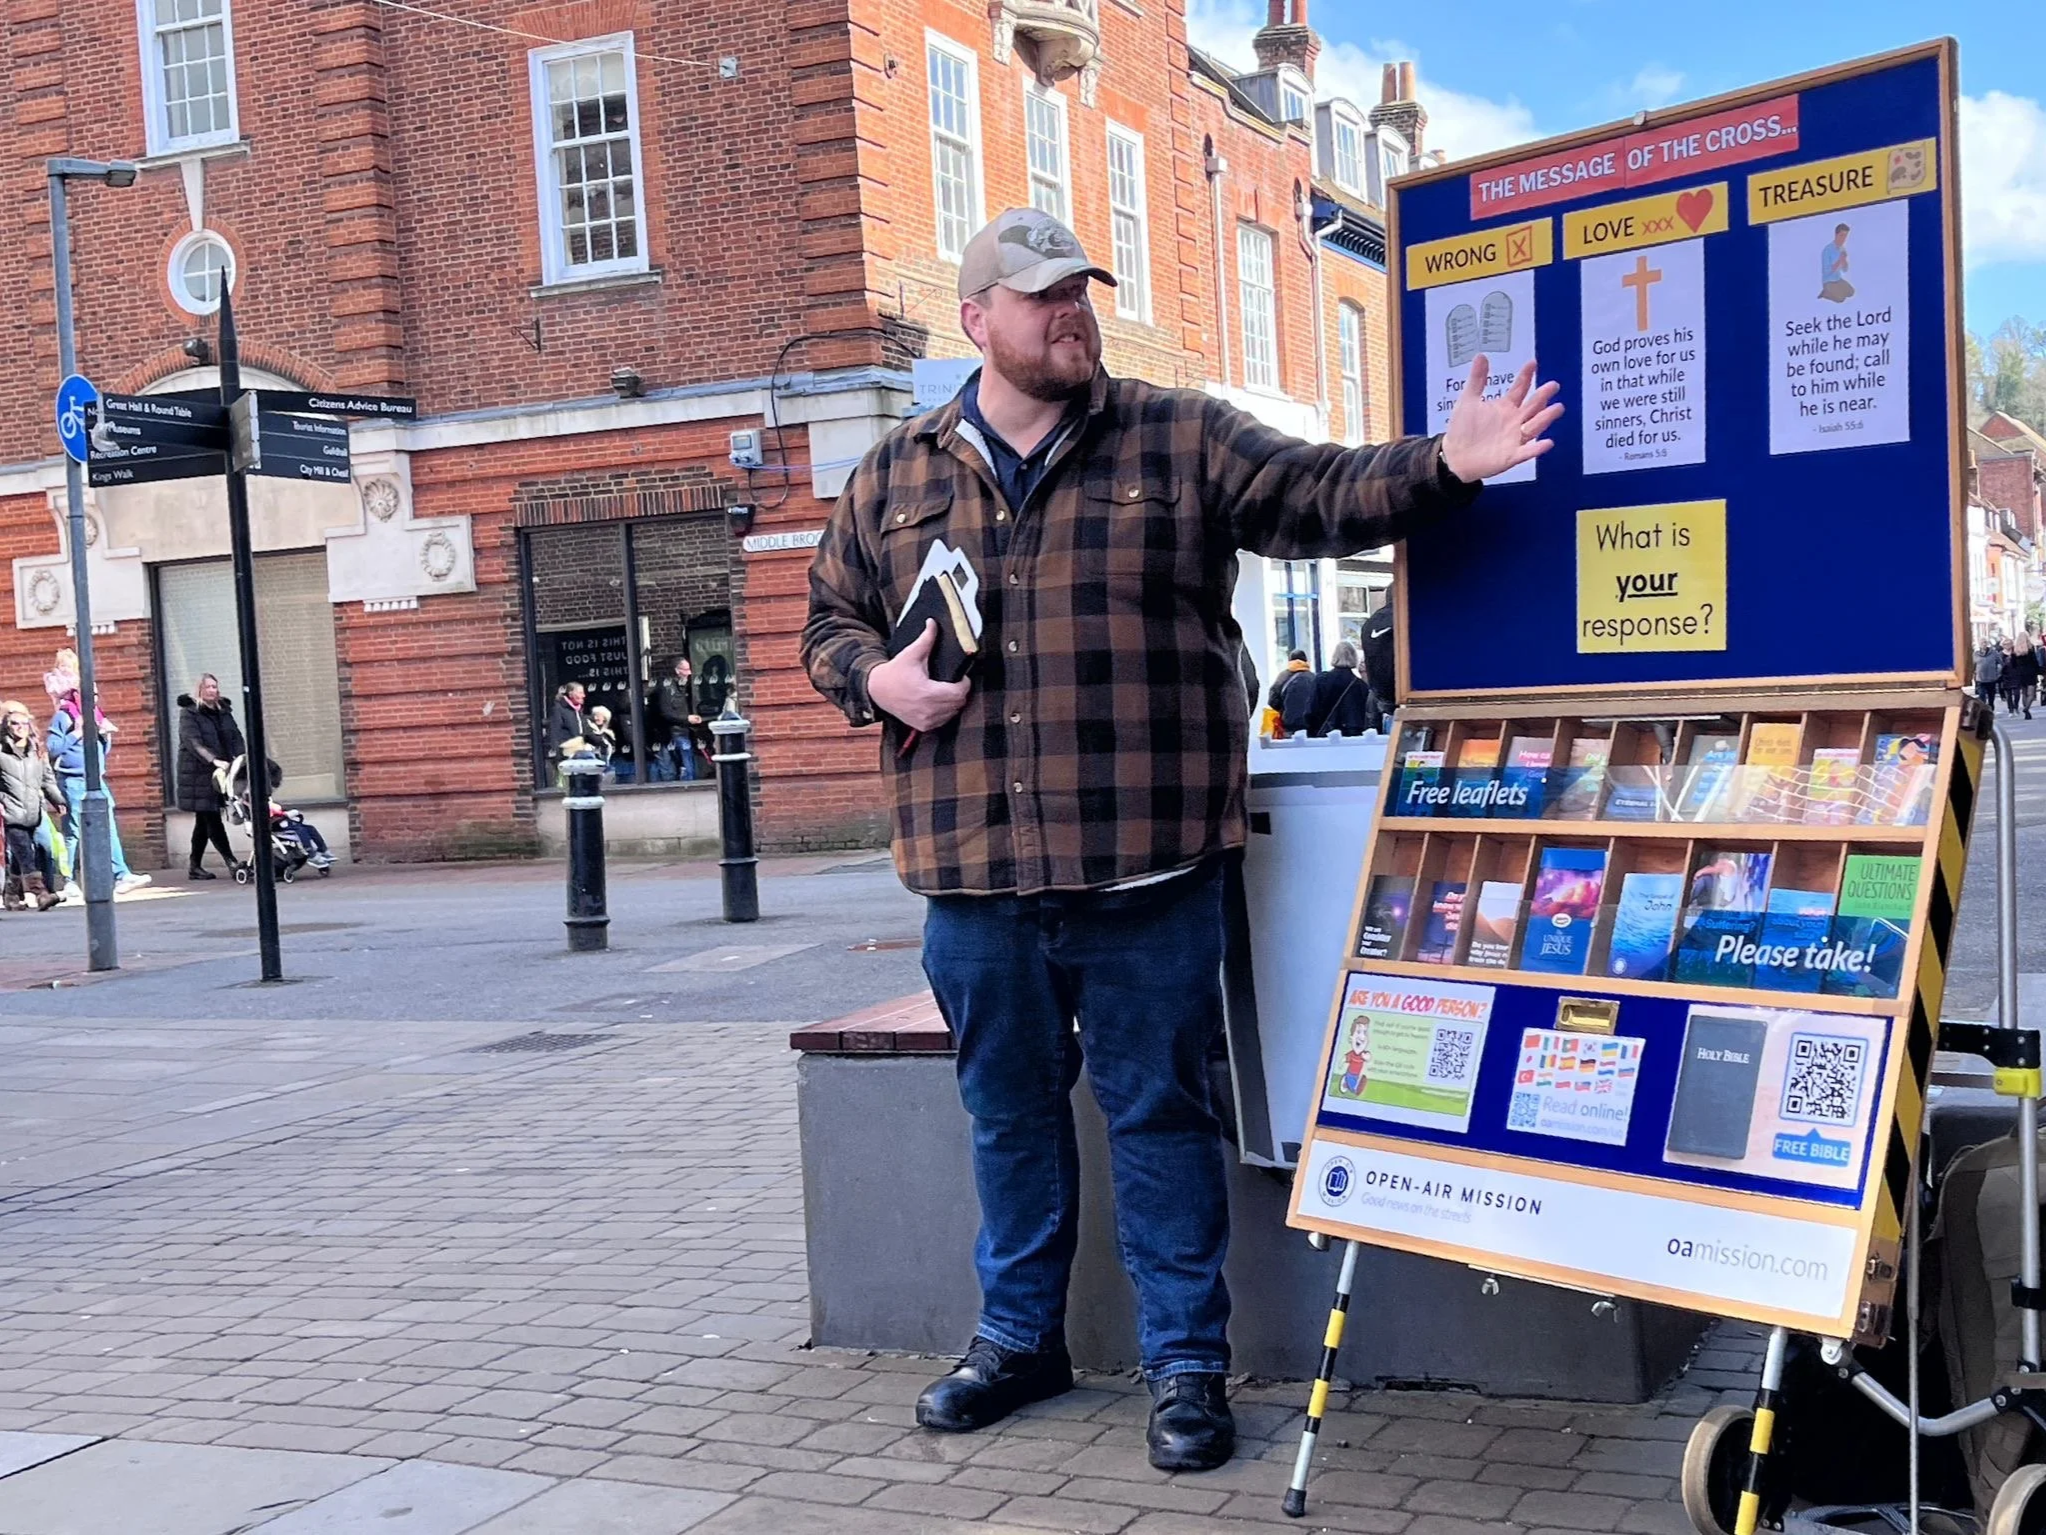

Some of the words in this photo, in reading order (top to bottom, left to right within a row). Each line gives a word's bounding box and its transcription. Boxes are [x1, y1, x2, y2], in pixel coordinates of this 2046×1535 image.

[1478, 181, 1515, 202] THE
[1519, 153, 1616, 194] MESSAGE
[1627, 145, 1655, 170] OF
[1661, 135, 1702, 163] THE
[1705, 115, 1798, 152] CROSS...
[1759, 166, 1874, 208] TREASURE
[1583, 217, 1635, 244] LOVE
[1425, 244, 1497, 274] WRONG
[1785, 317, 1821, 337] Seek
[1827, 314, 1852, 331] the
[1857, 306, 1892, 327] Lord
[1593, 337, 1620, 354] God
[1625, 334, 1670, 353] proves
[1674, 327, 1694, 343] his
[1787, 337, 1829, 357] while
[1833, 335, 1852, 350] he
[1857, 332, 1890, 349] may
[1591, 360, 1620, 374] own
[1624, 355, 1652, 370] love
[1657, 350, 1676, 365] for
[1680, 349, 1696, 361] us
[1786, 361, 1805, 378] be
[1809, 353, 1860, 375] found;
[1863, 349, 1890, 368] call
[1446, 378, 1466, 393] For
[1601, 379, 1613, 392] in
[1617, 373, 1645, 390] that
[1648, 368, 1685, 385] while
[1791, 384, 1806, 397] to
[1811, 379, 1839, 395] him
[1843, 372, 1886, 391] while
[106, 399, 127, 411] Great
[128, 401, 142, 412] Hall
[144, 404, 150, 413] &
[151, 403, 174, 416] Round
[174, 406, 192, 418] Table
[308, 397, 346, 410] Citizens
[347, 400, 379, 412] Advice
[380, 403, 413, 414] Bureau
[1601, 398, 1620, 411] we
[1623, 393, 1657, 408] were
[1661, 386, 1686, 403] still
[1800, 401, 1818, 417] he
[1823, 399, 1835, 414] is
[1839, 397, 1877, 413] near.
[107, 421, 141, 436] Museums
[314, 422, 347, 436] Information
[1595, 412, 1646, 431] sinners,
[1650, 406, 1692, 424] Christ
[1819, 422, 1843, 433] Isaiah
[131, 446, 157, 455] Centre
[1605, 431, 1635, 448] died
[1638, 430, 1658, 445] for
[1662, 430, 1681, 442] us.
[1624, 451, 1654, 461] Romans
[92, 472, 112, 482] Kings
[113, 469, 134, 479] Walk
[300, 464, 313, 476] City
[313, 466, 324, 475] Mill
[747, 535, 788, 549] MIDDLE
[792, 532, 823, 546] BROO
[1596, 520, 1662, 551] What
[1672, 522, 1690, 547] is
[1616, 572, 1678, 602] your
[1583, 603, 1713, 646] response?
[1406, 780, 1450, 804] Free
[1452, 780, 1529, 808] leaflets
[1861, 863, 1917, 881] ULTIMATE
[1847, 880, 1914, 900] QUESTIONS
[1644, 899, 1672, 911] John
[1704, 918, 1756, 934] Suffering?
[1539, 942, 1572, 956] JESUS
[1543, 934, 1574, 945] UNIQUE
[1715, 935, 1797, 969] Please
[1804, 941, 1876, 973] take!
[1349, 990, 1370, 1006] ARE
[1370, 992, 1391, 1008] YOU
[1391, 993, 1402, 1009] A
[1402, 995, 1435, 1012] GOOD
[1435, 998, 1488, 1018] PERSON?
[1697, 1047, 1723, 1061] HOLY
[1723, 1049, 1750, 1064] BIBLE
[1543, 1096, 1580, 1115] Read
[1580, 1103, 1629, 1122] online!
[1774, 1139, 1807, 1156] FREE
[1810, 1142, 1850, 1161] BIBLE
[1366, 1170, 1453, 1199] OPEN-AIR
[1461, 1187, 1543, 1215] MISSION
[1361, 1192, 1386, 1207] Good
[1387, 1197, 1410, 1211] news
[1410, 1202, 1423, 1213] on
[1423, 1202, 1440, 1216] the
[1441, 1206, 1472, 1223] streets
[1667, 1238, 1828, 1281] oamission.com
